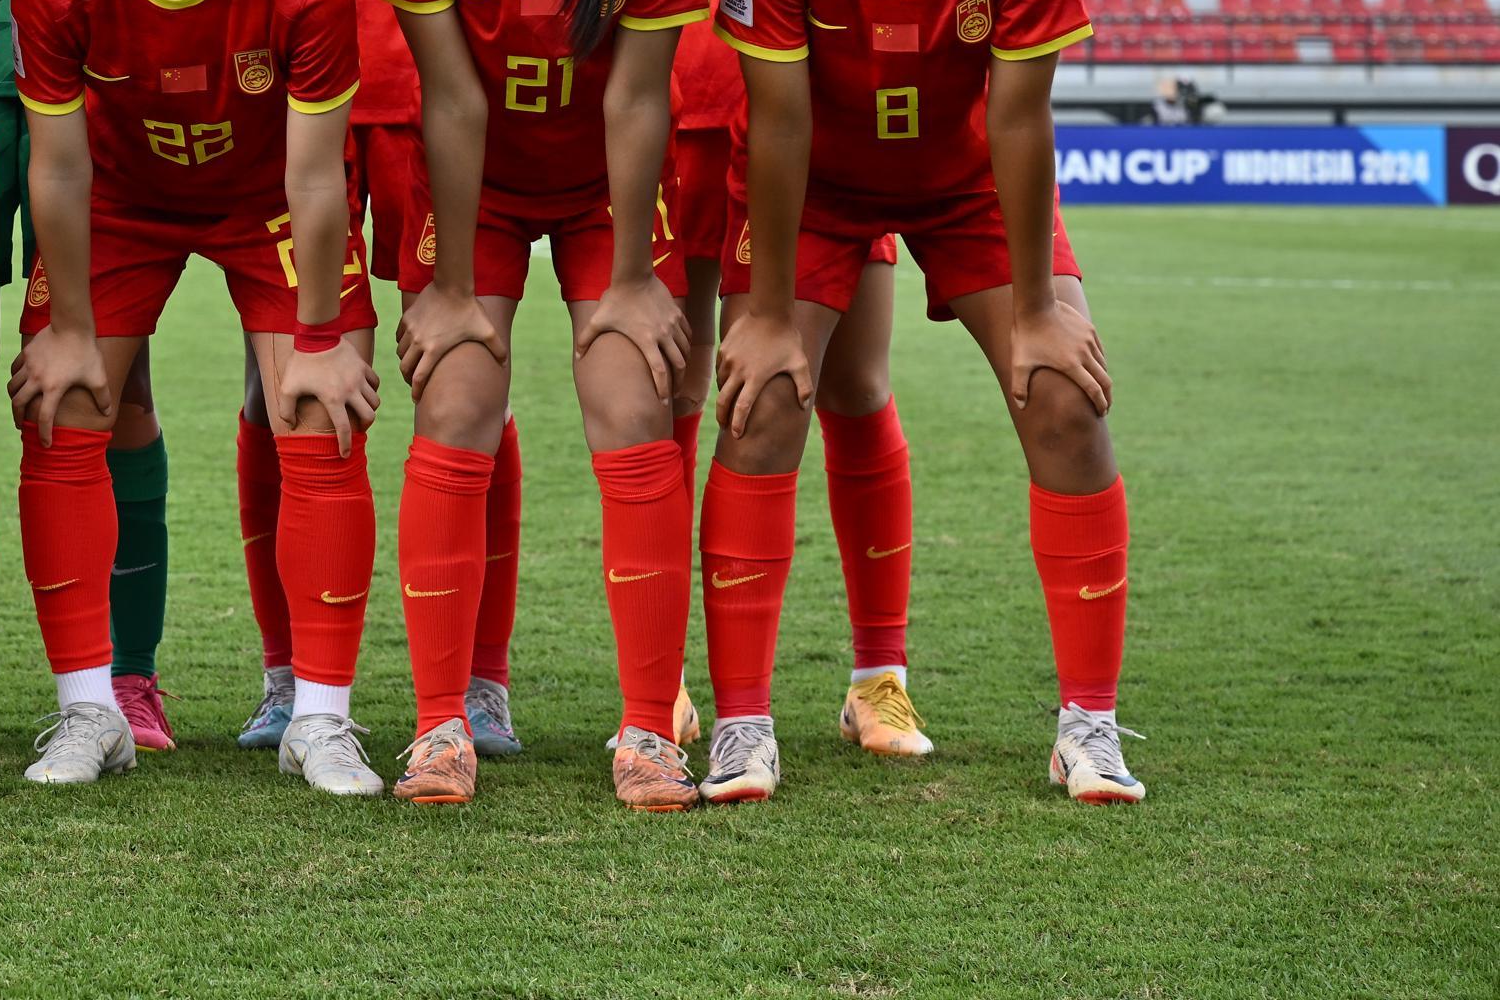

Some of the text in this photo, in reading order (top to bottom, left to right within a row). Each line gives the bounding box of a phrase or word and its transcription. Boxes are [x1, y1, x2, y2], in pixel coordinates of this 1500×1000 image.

[238, 51, 269, 63] CFA
[505, 56, 573, 113] 21
[876, 87, 919, 139] 8
[144, 120, 232, 165] 22
[1122, 149, 1209, 185] CUP
[1222, 149, 1355, 185] INDONESIA
[1358, 149, 1429, 185] 2024
